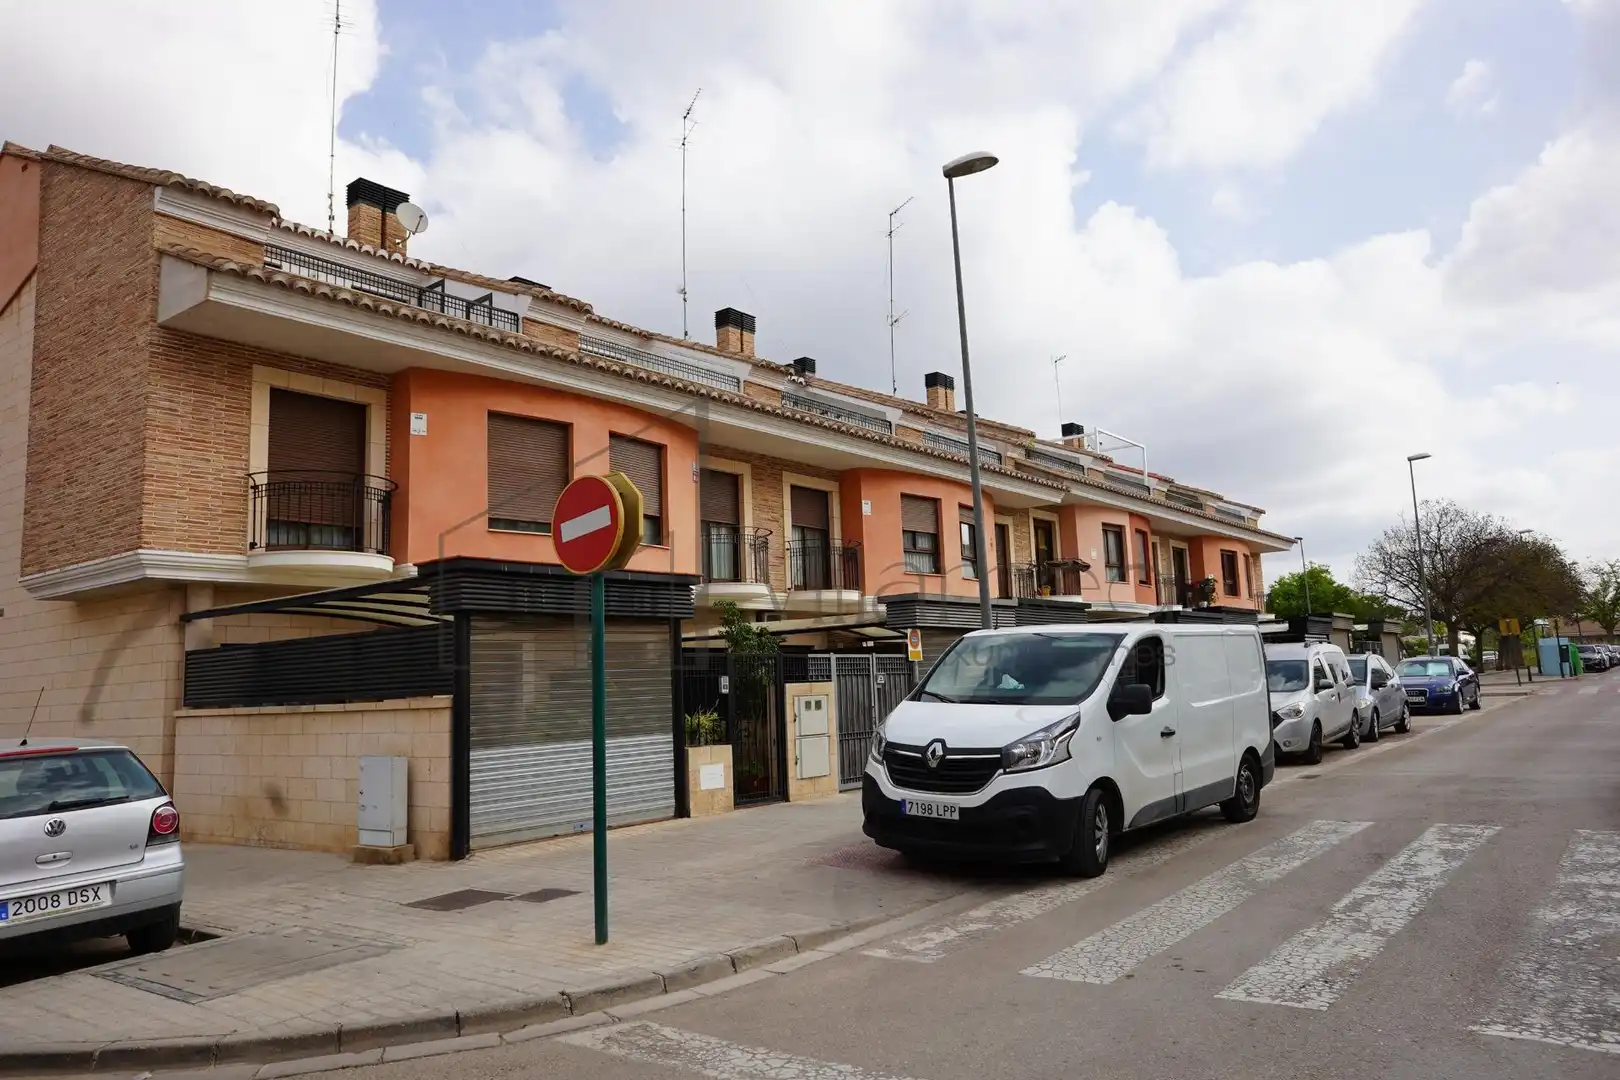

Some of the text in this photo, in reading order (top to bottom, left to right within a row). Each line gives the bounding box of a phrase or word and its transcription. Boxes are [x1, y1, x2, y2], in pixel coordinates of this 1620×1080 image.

[908, 801, 957, 818] 7198 LPP
[12, 894, 61, 916] 2008
[68, 886, 101, 906] DSX
